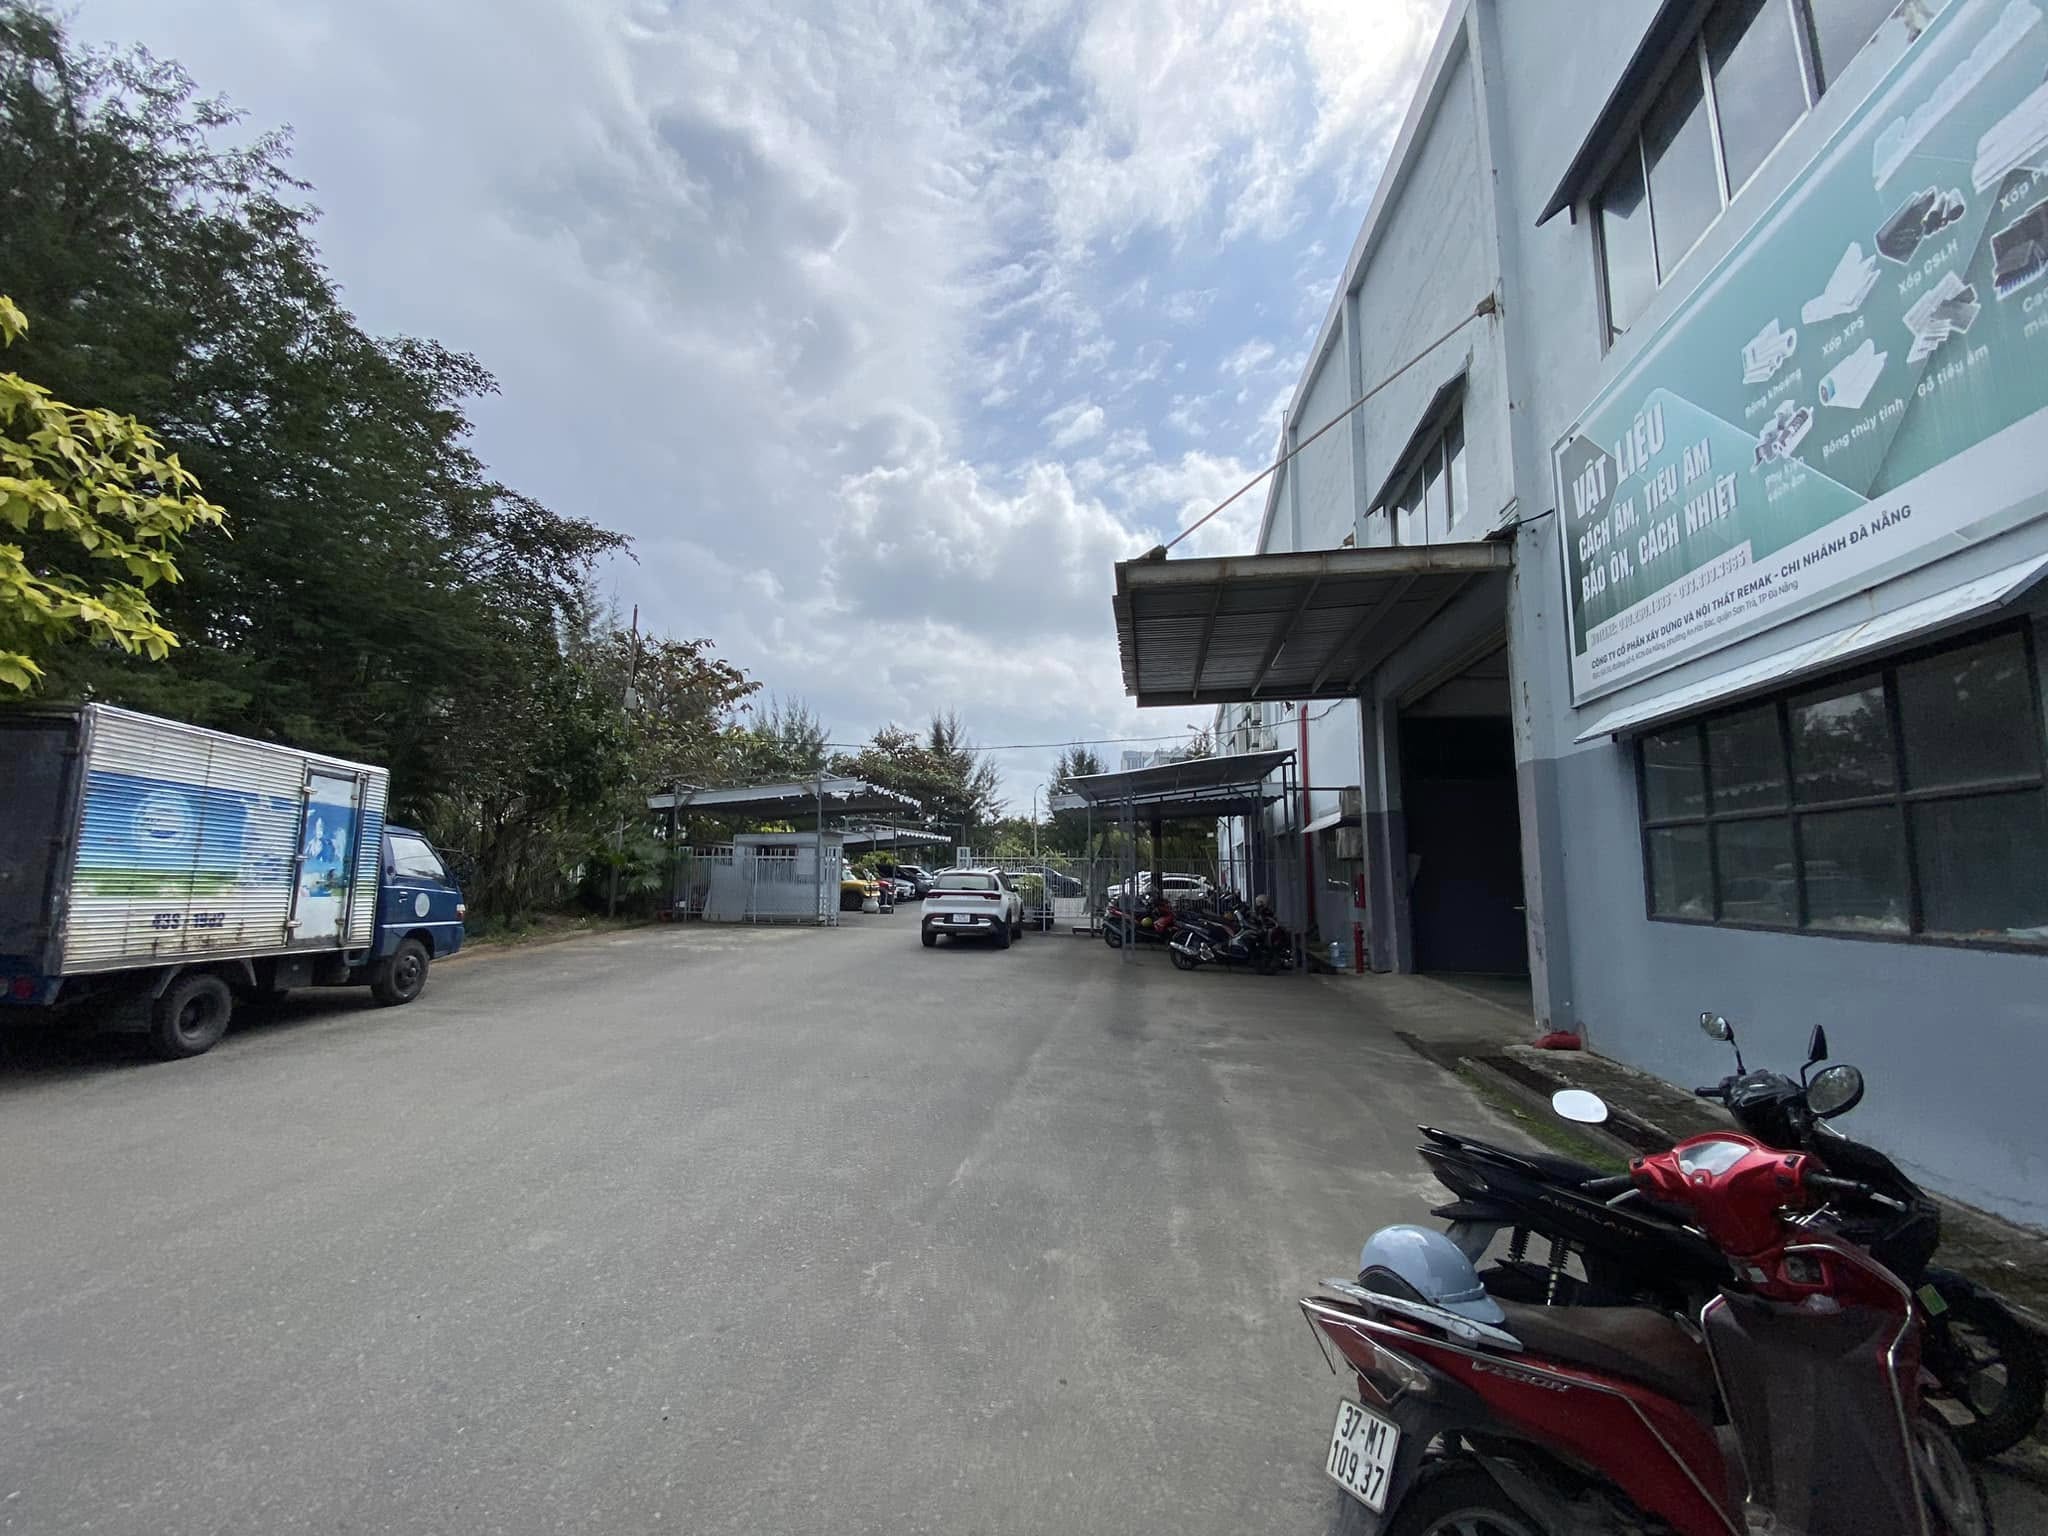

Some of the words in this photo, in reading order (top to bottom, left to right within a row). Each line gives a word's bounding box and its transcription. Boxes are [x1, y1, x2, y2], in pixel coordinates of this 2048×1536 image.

[1843, 315, 1865, 339] XPS
[1572, 453, 1607, 520] VẬT
[1614, 400, 1666, 486] LIỆU
[1578, 516, 1611, 563] CÁCH
[1614, 497, 1641, 538] ÂM,
[1643, 463, 1679, 514] TIÊU
[1683, 437, 1713, 488] ÂM
[1581, 560, 1607, 604] BẢO
[1638, 512, 1680, 566] CÁCH
[1683, 470, 1738, 538] NHIỆT
[1591, 654, 1609, 670] CÔNG
[1607, 650, 1617, 661] TY
[1626, 634, 1645, 653] PHẦN
[1645, 628, 1660, 645] XÂY
[1660, 617, 1683, 637] DỰNG
[1683, 610, 1695, 625] VÀ
[1695, 602, 1711, 620] NỘI
[1711, 589, 1736, 611] THẤT
[1737, 573, 1773, 599] REMAK
[1780, 562, 1801, 579] CHI
[1803, 536, 1847, 568] NHÁNH
[1849, 523, 1869, 545] ĐÀ
[1870, 504, 1912, 535] NẴNG
[1330, 1439, 1385, 1501] 109.37
[1341, 1405, 1388, 1460] 37-M1
